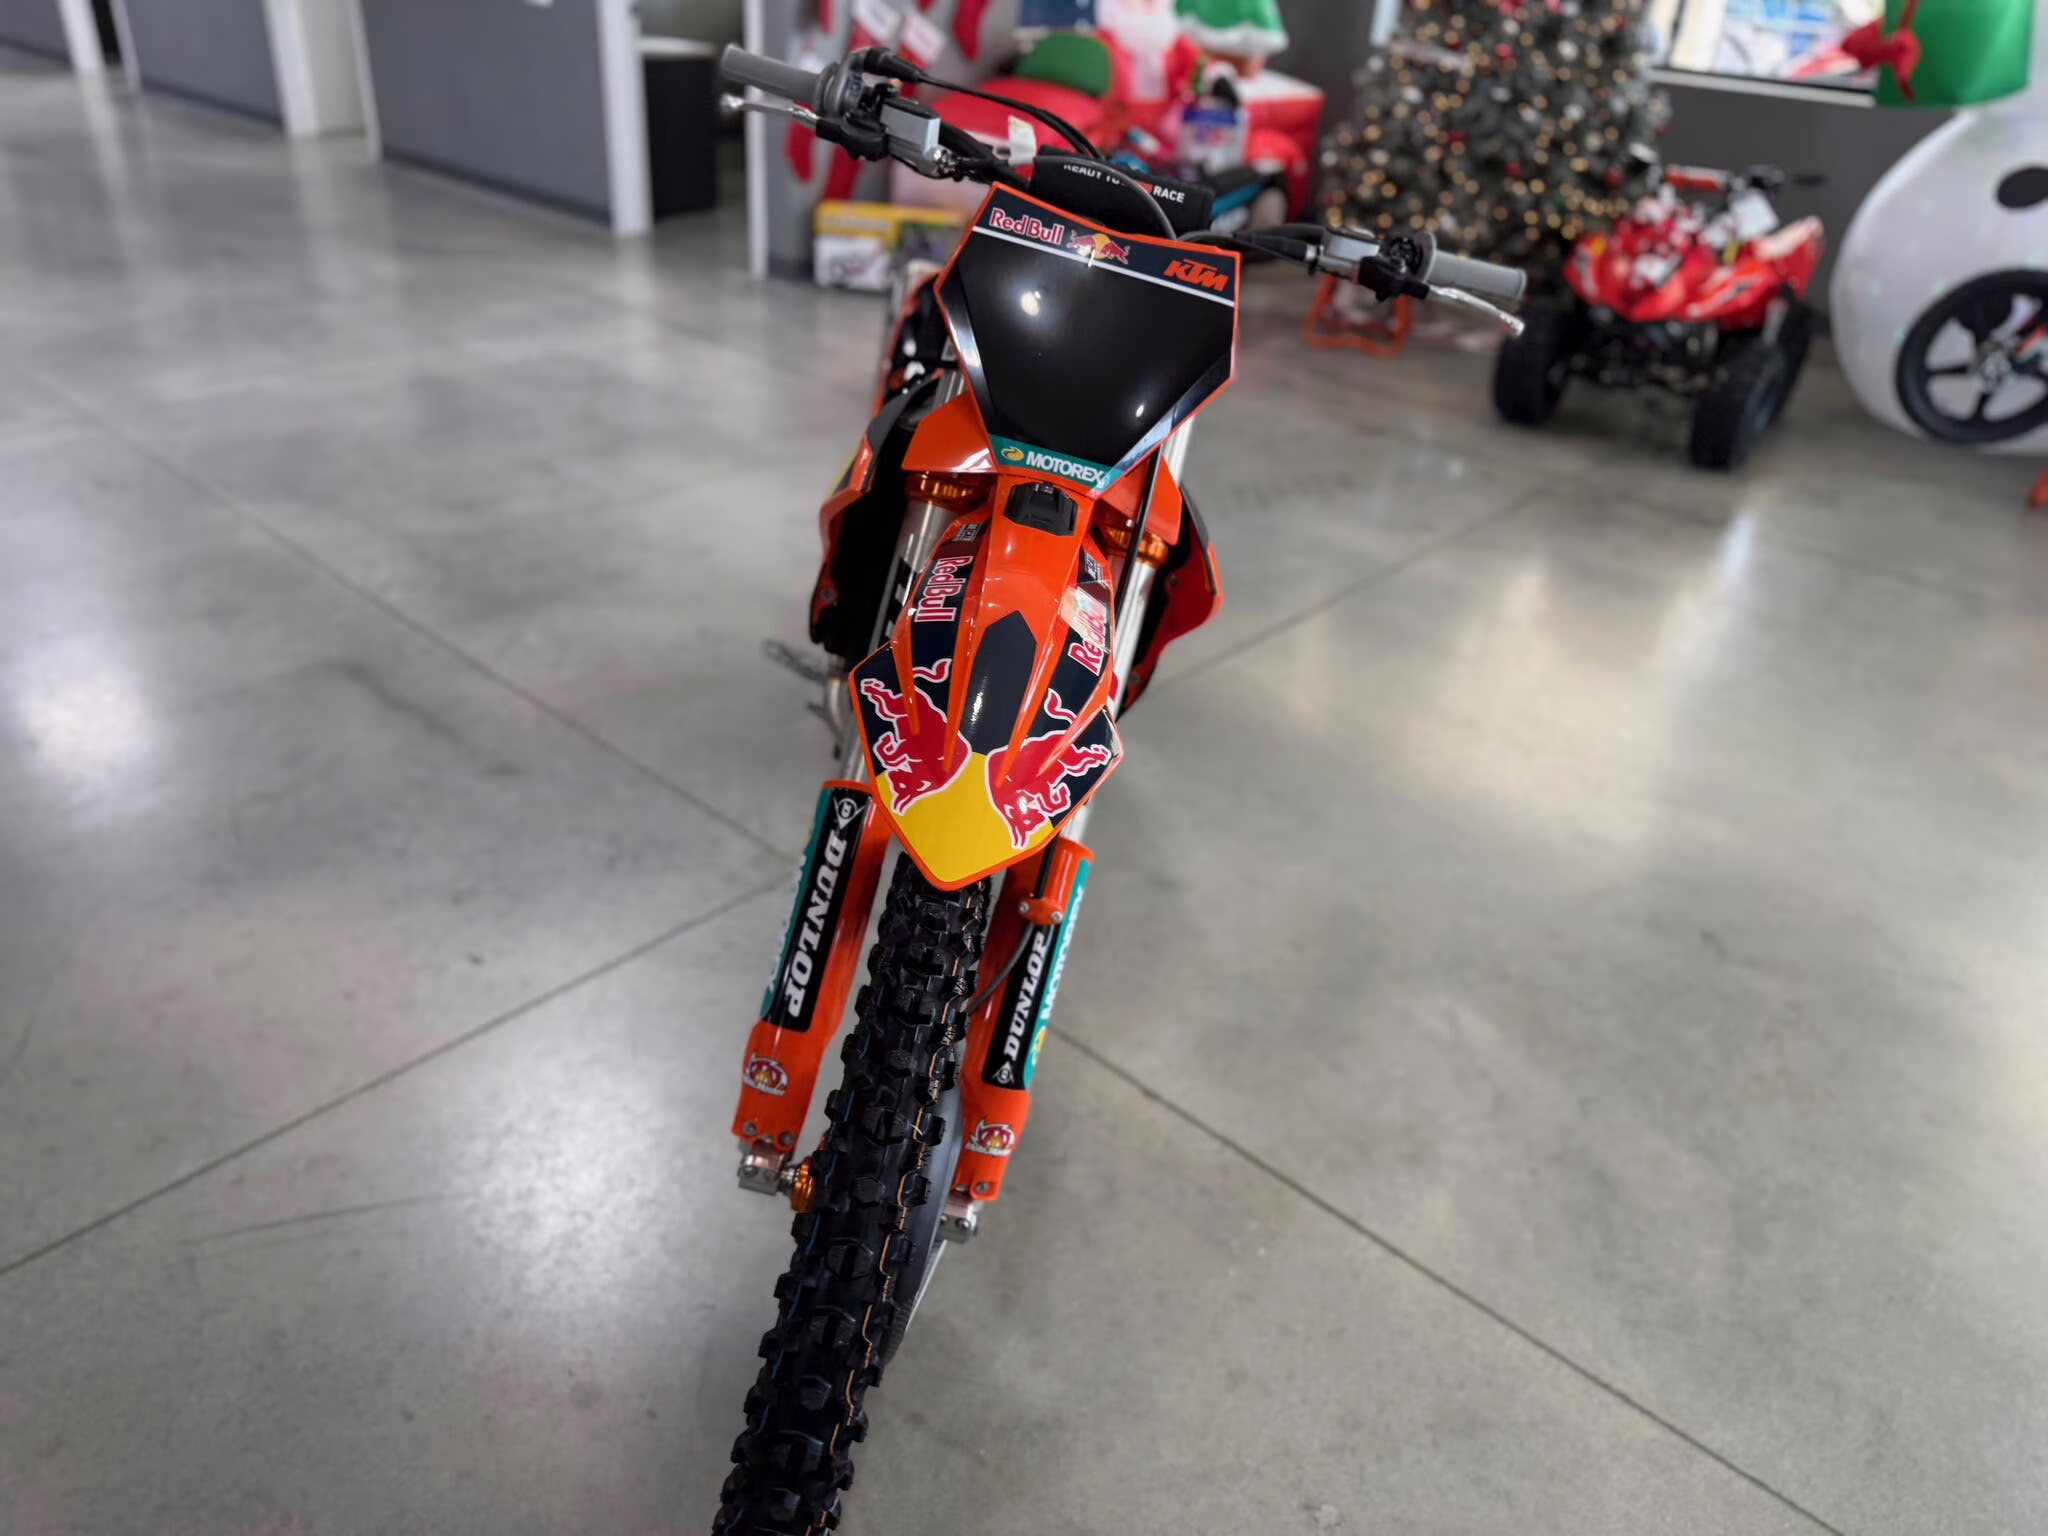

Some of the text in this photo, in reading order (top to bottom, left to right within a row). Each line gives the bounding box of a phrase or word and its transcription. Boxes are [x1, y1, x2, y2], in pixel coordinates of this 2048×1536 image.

[1153, 185, 1185, 203] RACE
[1163, 258, 1229, 292] KTM
[1026, 451, 1104, 488] MOTOREX
[785, 829, 848, 1018] DUNLOP
[1003, 931, 1048, 1062] DUNLOP
